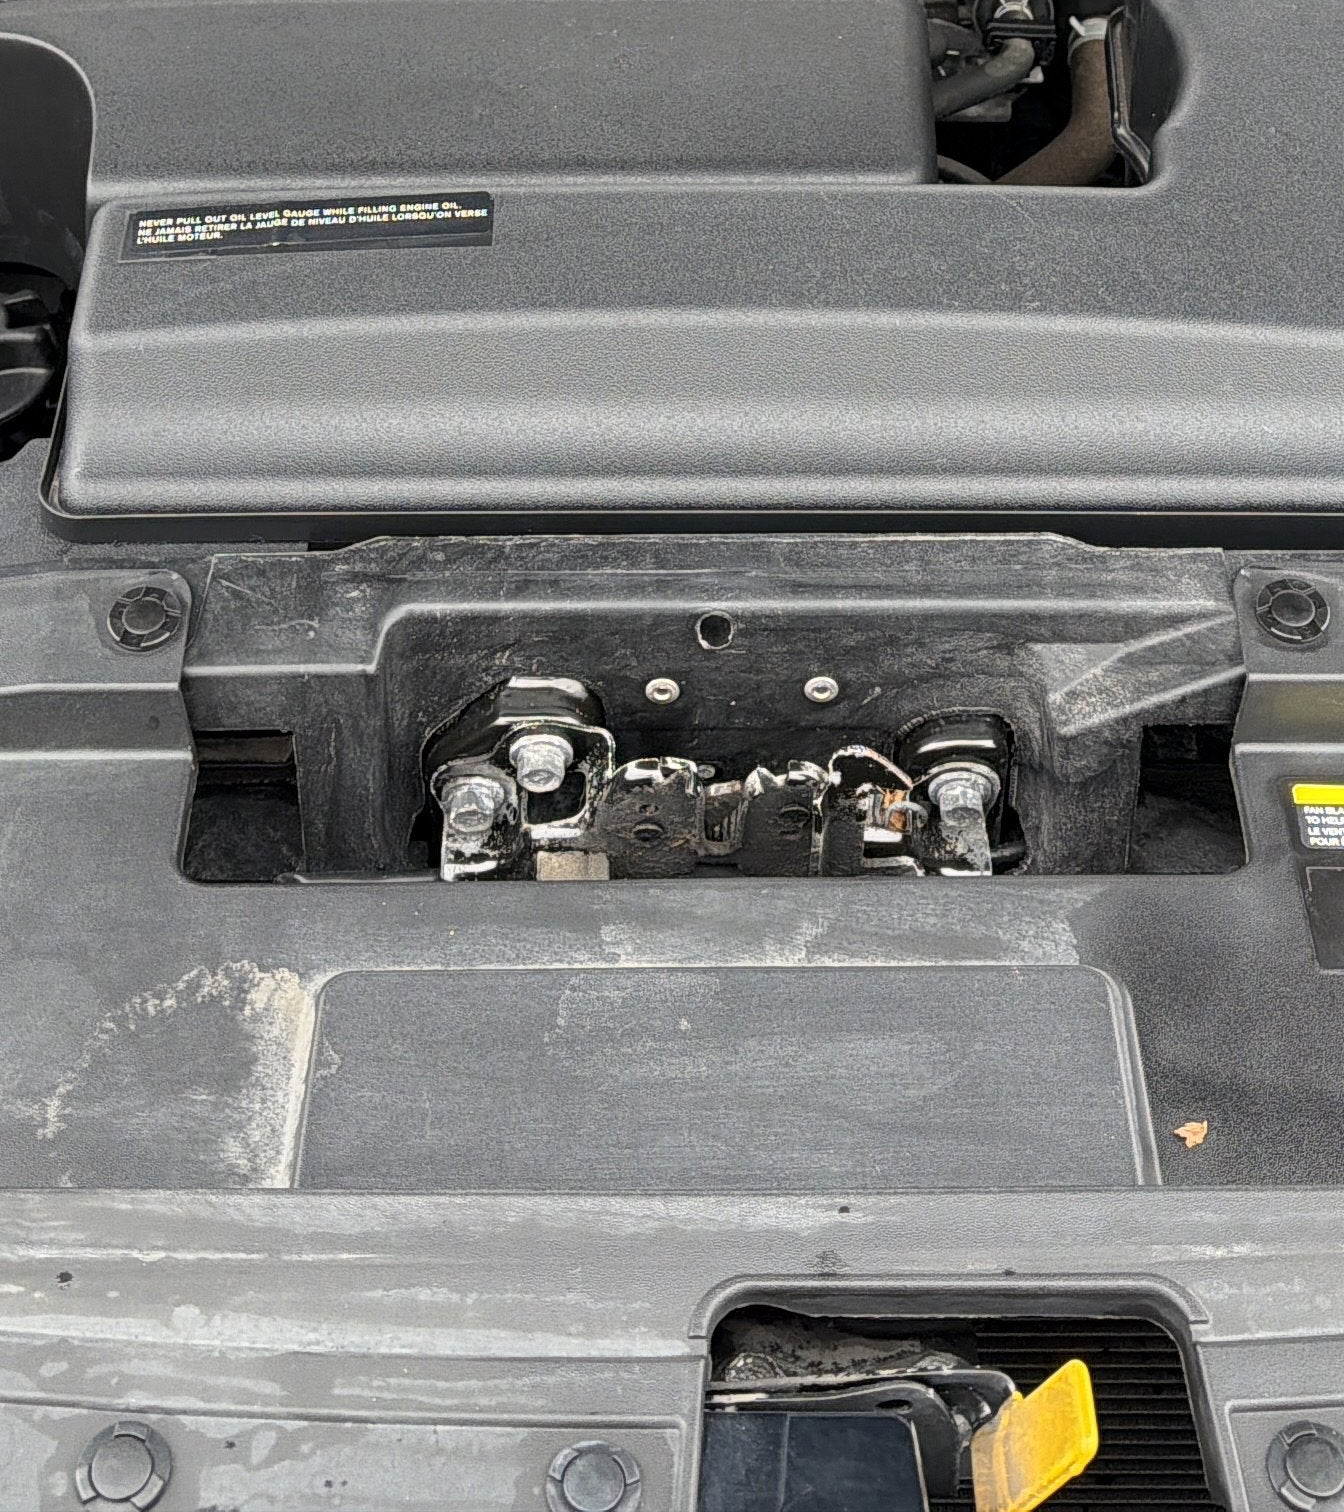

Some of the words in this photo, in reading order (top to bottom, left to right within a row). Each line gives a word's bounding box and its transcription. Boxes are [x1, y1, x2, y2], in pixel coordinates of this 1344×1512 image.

[139, 218, 173, 227] NEVER
[176, 216, 202, 225] PULL
[205, 214, 227, 223] OUT
[230, 213, 246, 221] OIL
[250, 210, 280, 220] LEVEL
[283, 209, 320, 218] GAUGE
[323, 207, 355, 216] WHILE
[358, 204, 396, 214] FILLING
[399, 202, 439, 212] ENGINE
[441, 201, 462, 210] OIL.
[138, 228, 152, 236] NE
[155, 226, 192, 235] JAMAIS
[195, 223, 238, 232] RETIRER
[240, 221, 253, 230] LA
[256, 218, 288, 229] JAUGE
[291, 218, 306, 227] DE
[308, 216, 346, 226] NIVEAU
[348, 213, 389, 224] D'HUILE
[392, 210, 452, 221] LORSQU'ON
[455, 209, 488, 218] VERSE
[137, 234, 175, 245] L'HUILE
[177, 232, 223, 242] MOTEUR.
[1303, 806, 1324, 815] FAN
[1305, 816, 1320, 824] TO
